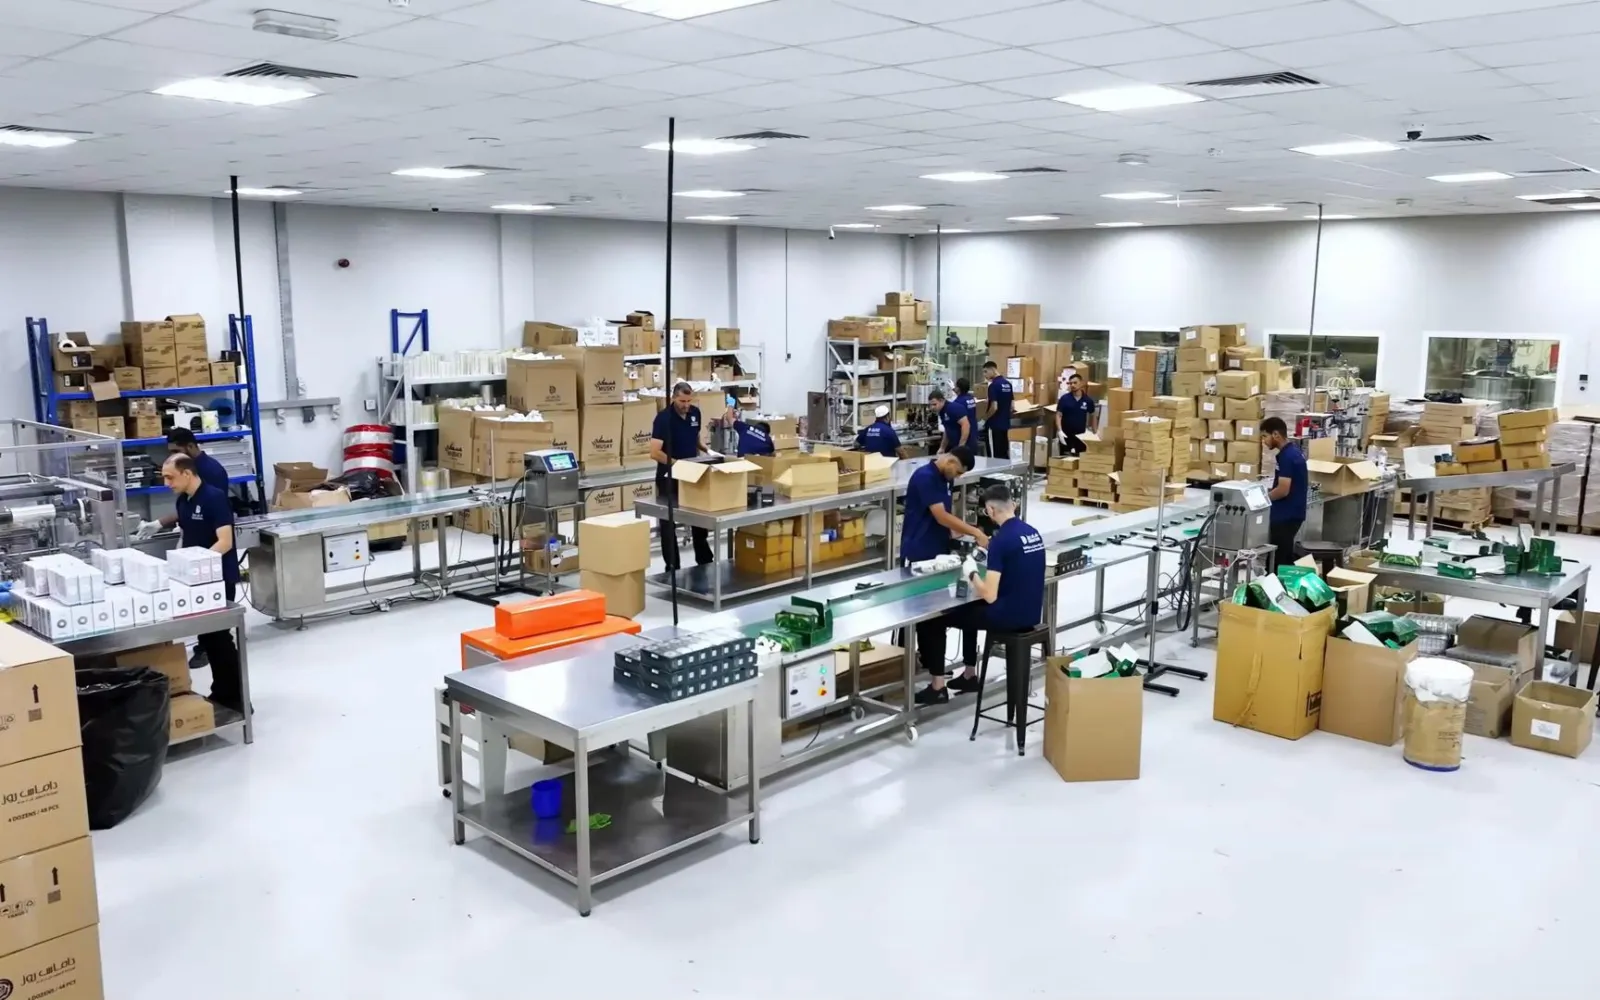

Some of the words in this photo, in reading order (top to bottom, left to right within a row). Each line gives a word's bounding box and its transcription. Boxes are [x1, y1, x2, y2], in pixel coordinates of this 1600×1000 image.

[1, 793, 18, 806] روز
[12, 811, 36, 822] DOZENS
[21, 972, 37, 987] روز
